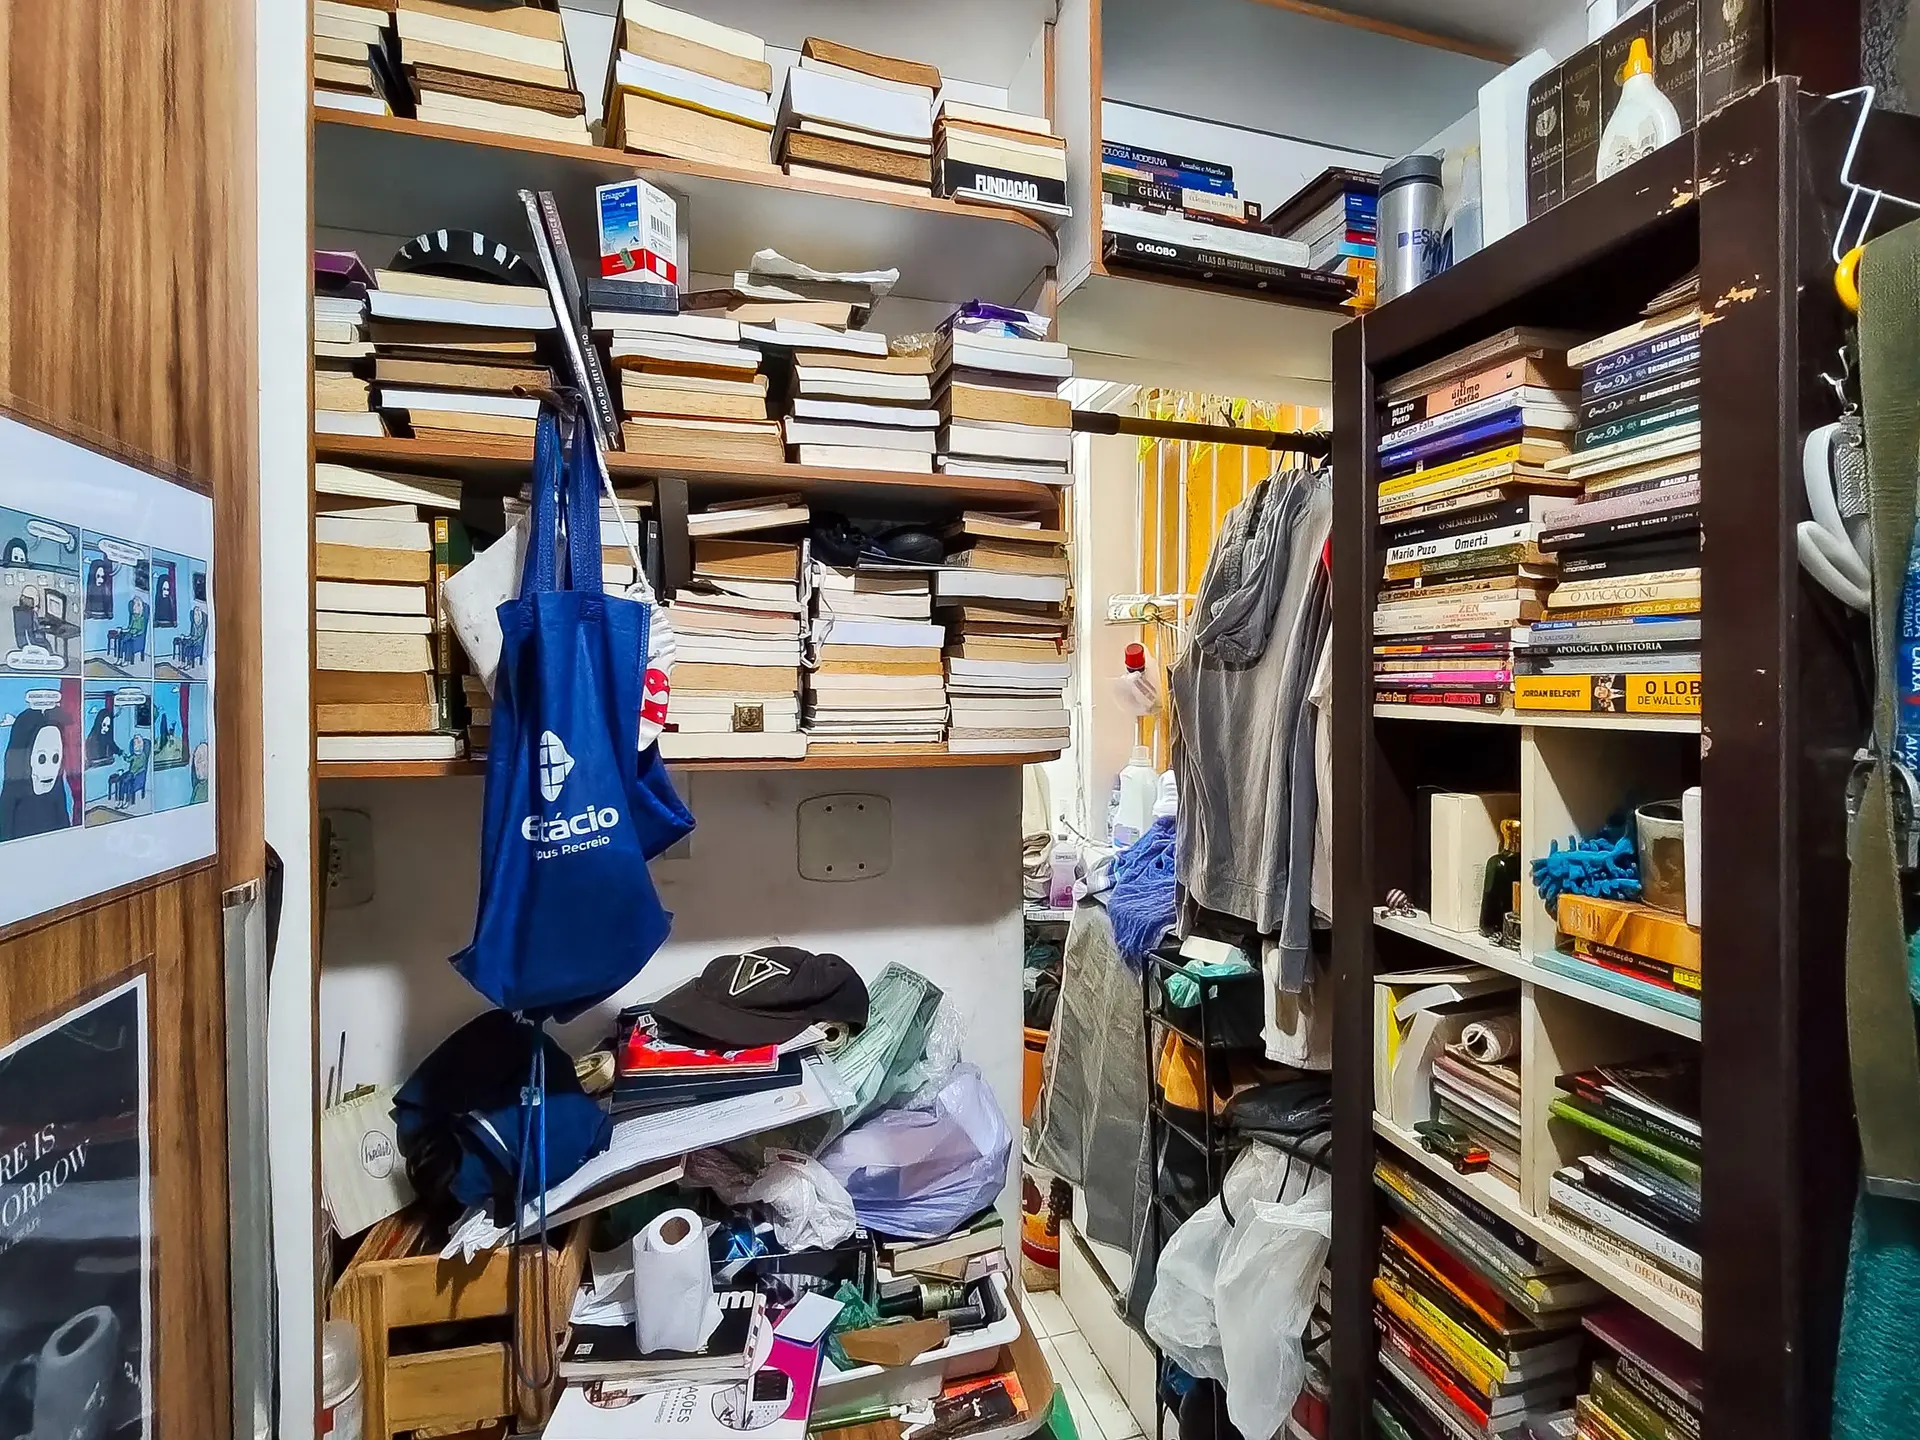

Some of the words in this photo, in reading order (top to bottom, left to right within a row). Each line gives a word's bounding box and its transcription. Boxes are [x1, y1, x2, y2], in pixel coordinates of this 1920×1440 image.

[1132, 152, 1168, 167] MODERNA
[1138, 186, 1172, 201] GERAL
[1136, 242, 1144, 252] O
[1144, 243, 1177, 258] GLOBO
[1197, 253, 1216, 266] ATLAS
[1217, 256, 1226, 267] DA
[1226, 257, 1254, 272] HISTÓRIA
[1254, 261, 1286, 278] UNIVERSAL
[1451, 383, 1480, 400] último
[1392, 402, 1414, 417] Mario
[1392, 414, 1410, 426] Puzo
[1397, 426, 1417, 439] Corpo
[1419, 420, 1434, 432] Fala
[1660, 474, 1687, 487] ABAIXO
[1688, 473, 1699, 482] DE
[1642, 517, 1668, 526] SECRETO
[1391, 548, 1414, 561] Mario
[1417, 545, 1437, 556] Puzo
[1455, 533, 1488, 550] Omertà
[1570, 591, 1581, 602] O
[1583, 588, 1637, 601] MACACO
[1639, 586, 1659, 598] NU
[1459, 604, 1479, 613] ZEN
[1557, 645, 1599, 654] APOLOGIA
[1601, 644, 1614, 652] DA
[1616, 640, 1663, 652] HISTÓRIA
[1522, 689, 1548, 698] JORDAN
[1550, 689, 1581, 697] BELFORT
[1645, 681, 1656, 695] O
[1637, 696, 1651, 705] DE
[1653, 696, 1682, 706] WALL
[533, 848, 558, 861] pus
[561, 836, 610, 855] Recreio
[35, 1122, 55, 1161] IS
[1634, 1263, 1665, 1286] DIETA
